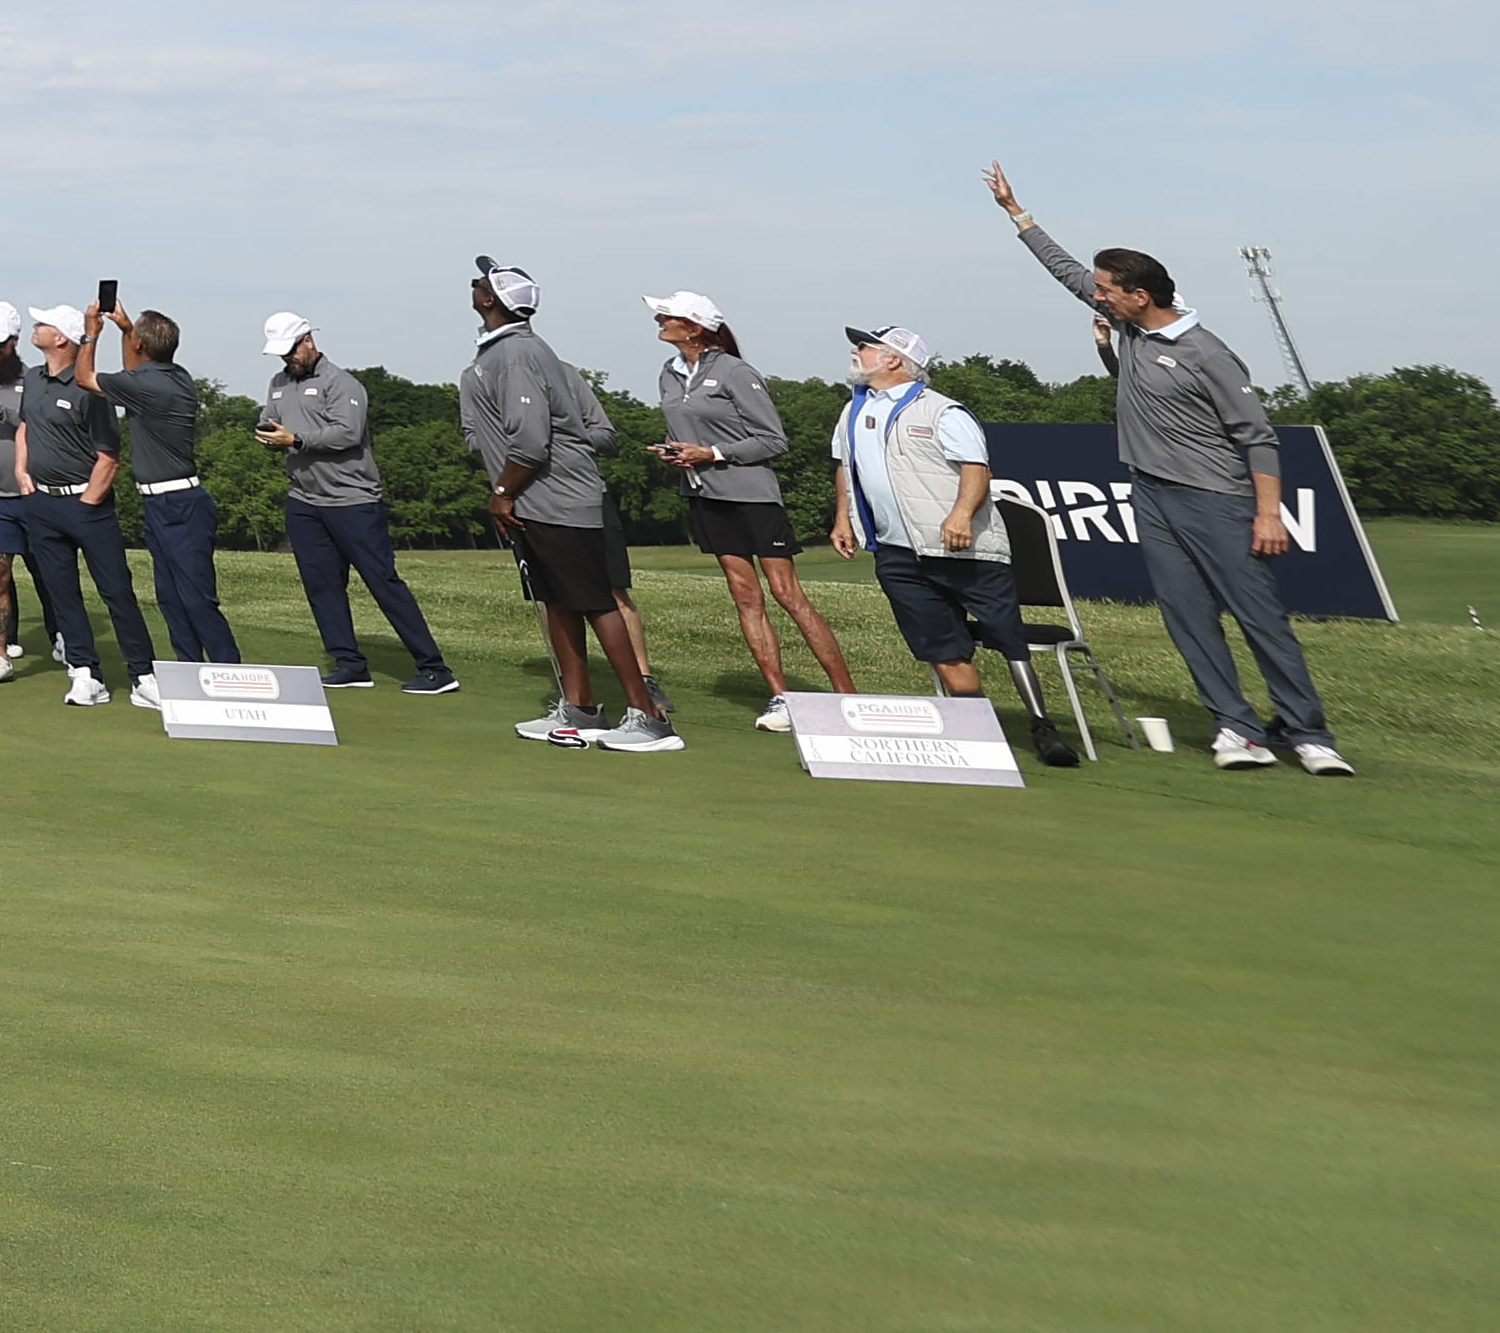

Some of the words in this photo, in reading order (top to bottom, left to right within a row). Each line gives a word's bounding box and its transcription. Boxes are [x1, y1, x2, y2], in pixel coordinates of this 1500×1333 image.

[211, 672, 241, 681] PGA
[241, 673, 272, 682] HOPE
[224, 708, 267, 720] UTAH
[857, 703, 894, 714] PGA
[894, 705, 932, 715] HOPE
[849, 737, 959, 753] NORTHERN
[850, 750, 970, 766] CALIFORNIA
